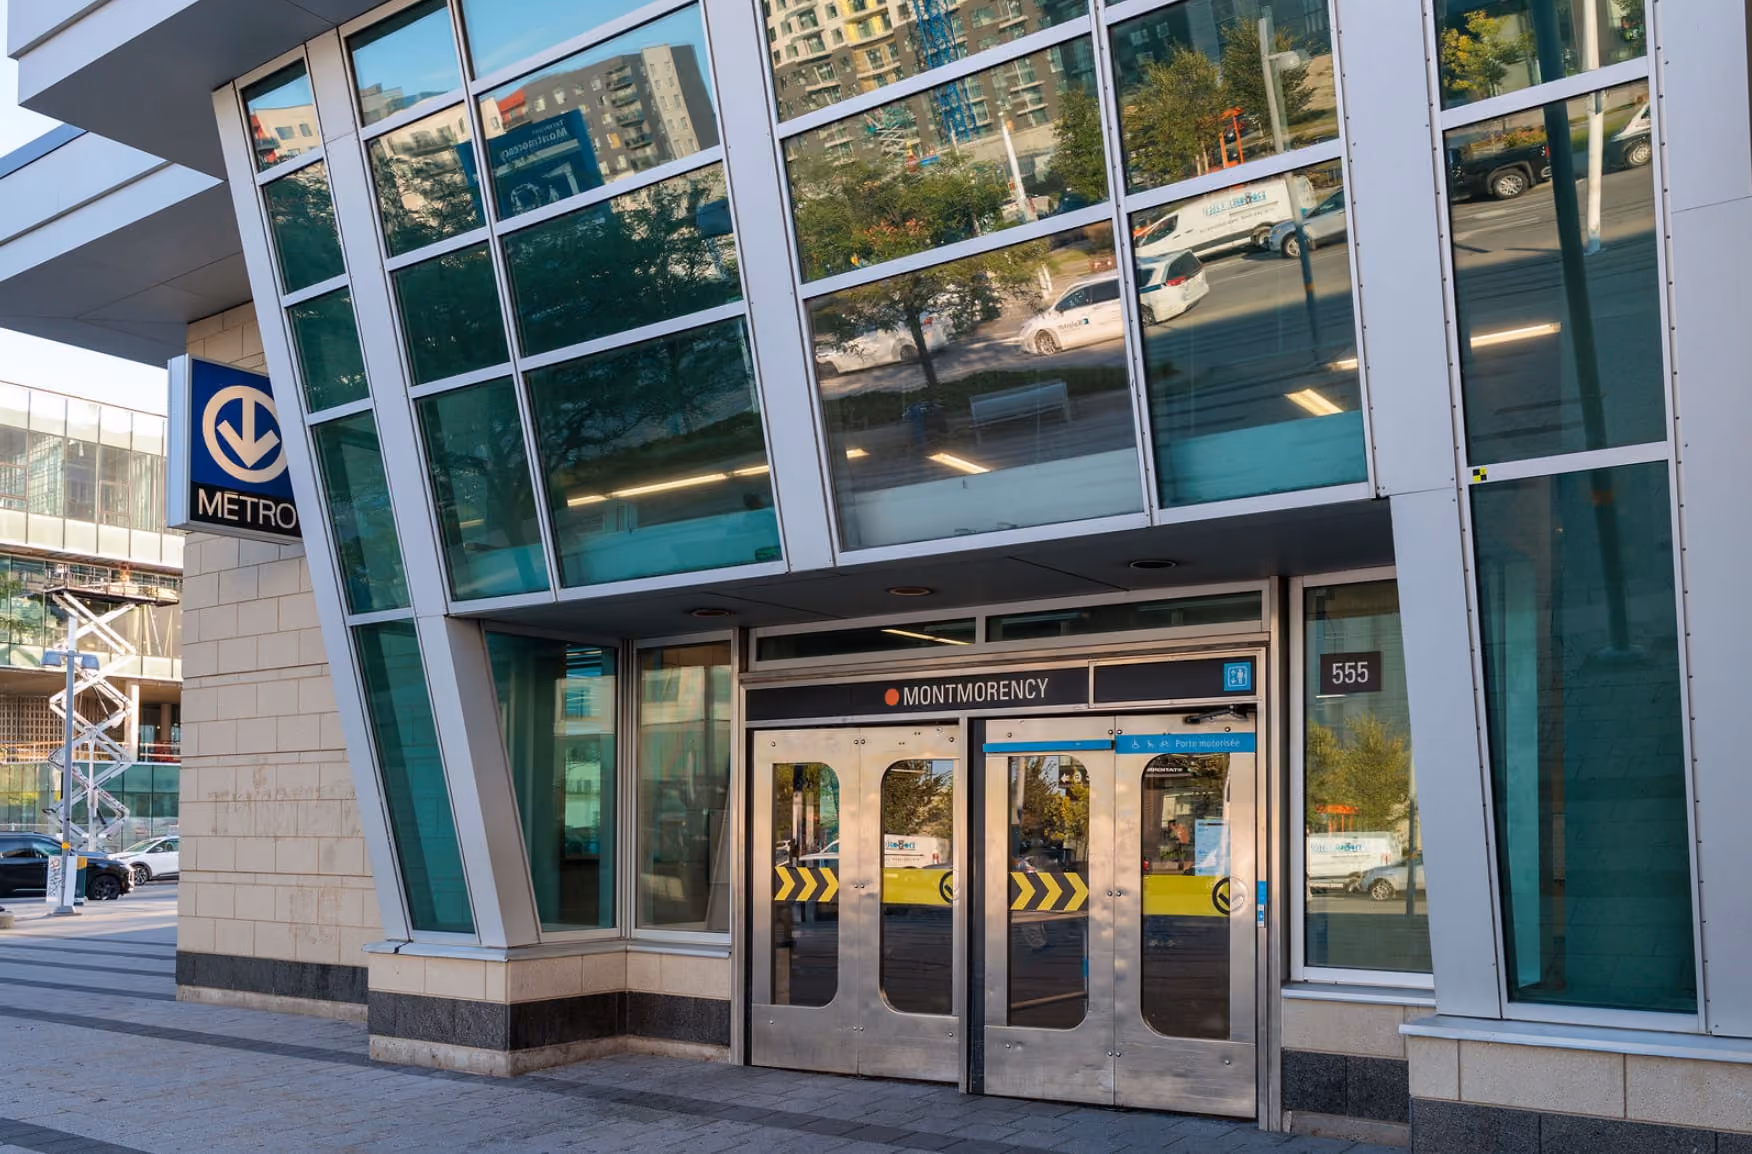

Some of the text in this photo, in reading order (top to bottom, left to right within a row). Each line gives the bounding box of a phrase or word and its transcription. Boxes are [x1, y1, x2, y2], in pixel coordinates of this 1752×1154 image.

[1332, 661, 1369, 685] 555
[903, 678, 1049, 706] MONTMORENCY
[1175, 739, 1197, 749] Porte
